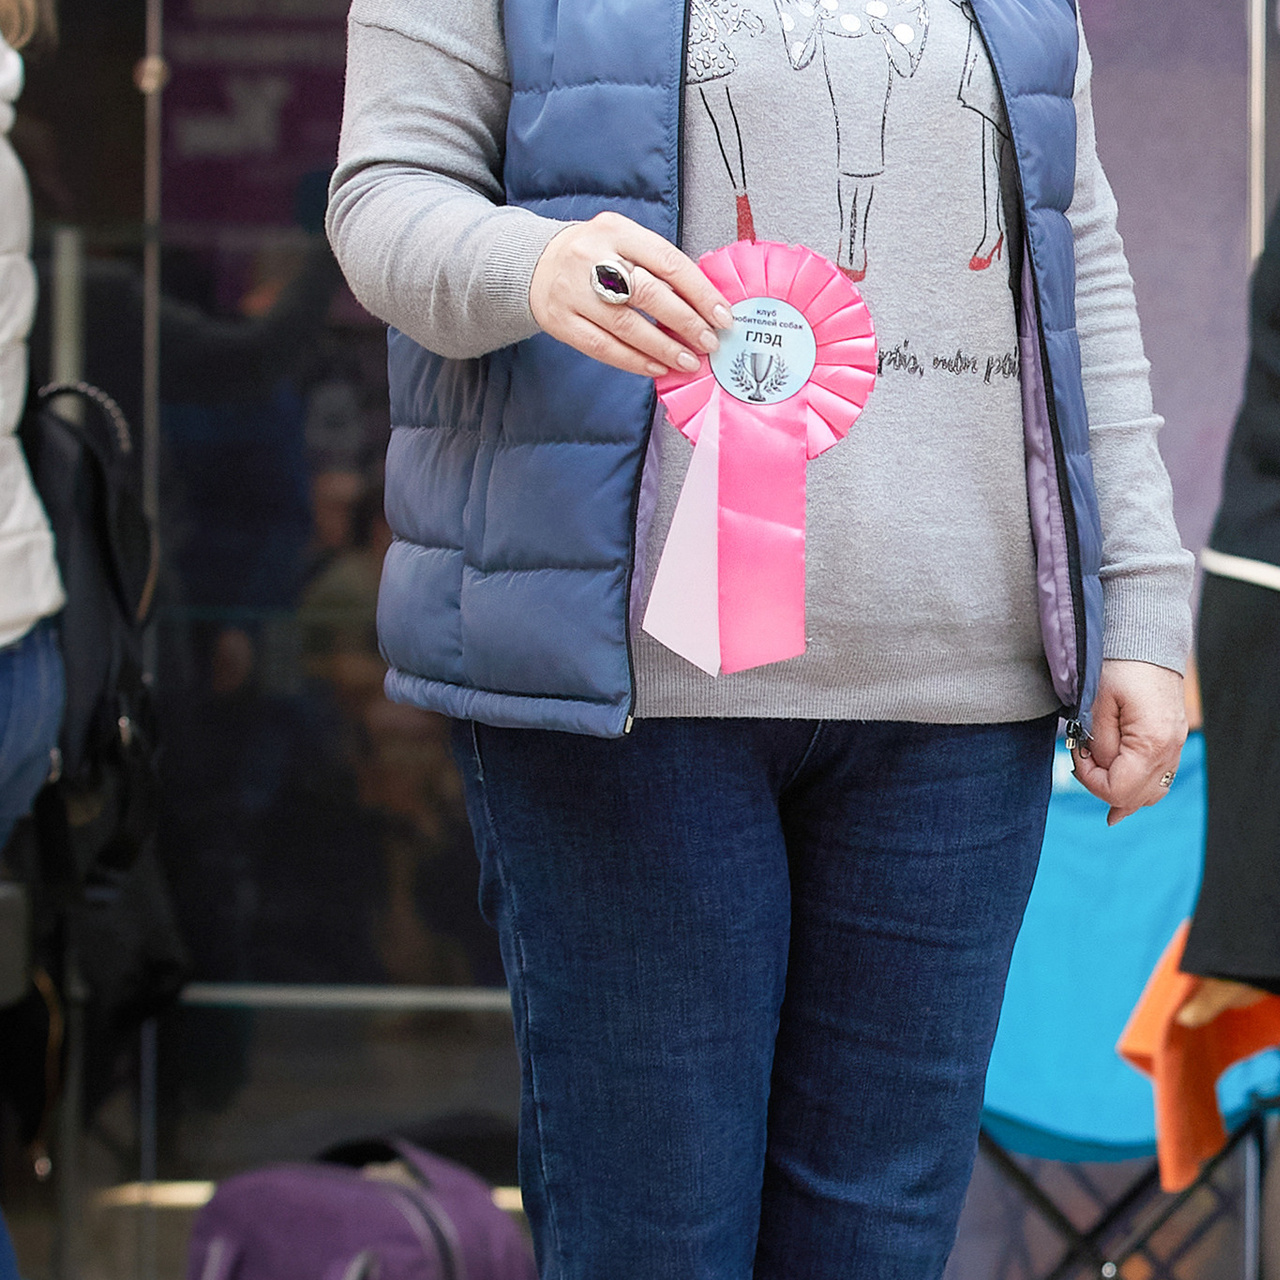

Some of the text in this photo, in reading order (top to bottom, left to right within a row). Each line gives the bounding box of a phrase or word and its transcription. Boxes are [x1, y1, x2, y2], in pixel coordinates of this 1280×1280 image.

[756, 308, 777, 318] клуб
[779, 321, 804, 331] собак
[745, 330, 783, 348] ГЛЭД
